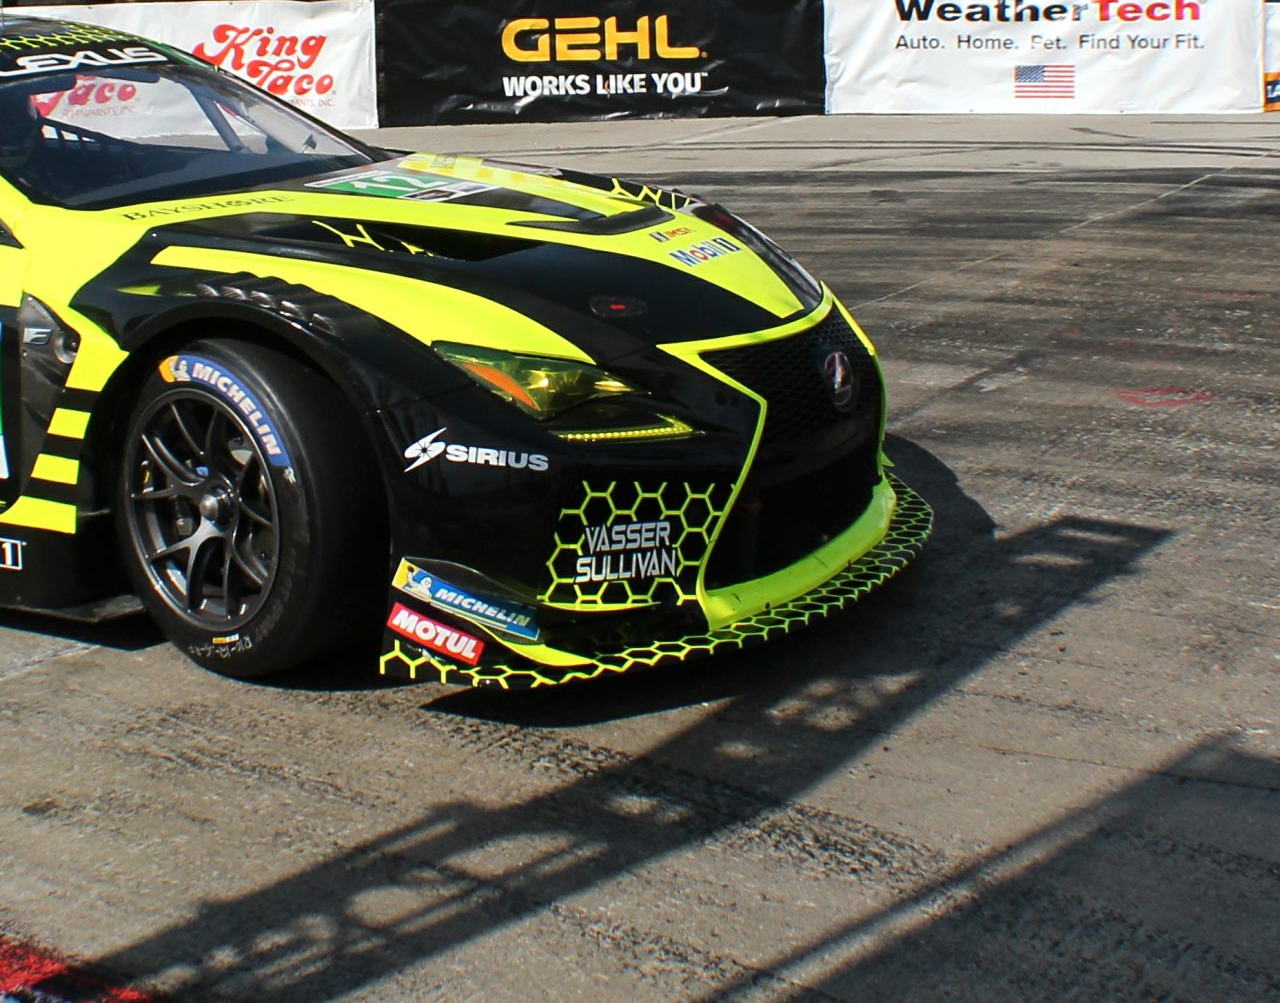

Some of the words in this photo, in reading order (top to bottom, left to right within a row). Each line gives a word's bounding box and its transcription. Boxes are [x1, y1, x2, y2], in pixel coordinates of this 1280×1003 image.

[192, 24, 327, 72] King
[501, 14, 700, 62] GEHL
[895, 34, 945, 50] Auto.
[957, 34, 1019, 50] Home.
[1030, 35, 1067, 50] Pet.
[1078, 33, 1121, 50] Find
[1125, 33, 1168, 50] Your
[1176, 33, 1205, 49] Fit.
[246, 59, 334, 96] Taco
[502, 75, 591, 97] WORKS
[596, 73, 647, 95] LIKE
[652, 72, 703, 94] YOU
[668, 240, 728, 267] Mobil
[191, 362, 282, 456] MICHELIN
[445, 444, 549, 471] SIRIUS
[585, 520, 671, 554] VASSER
[573, 549, 677, 583] SULLIVAN
[434, 587, 531, 628] MICHELIN
[392, 610, 478, 660] MOTUL
